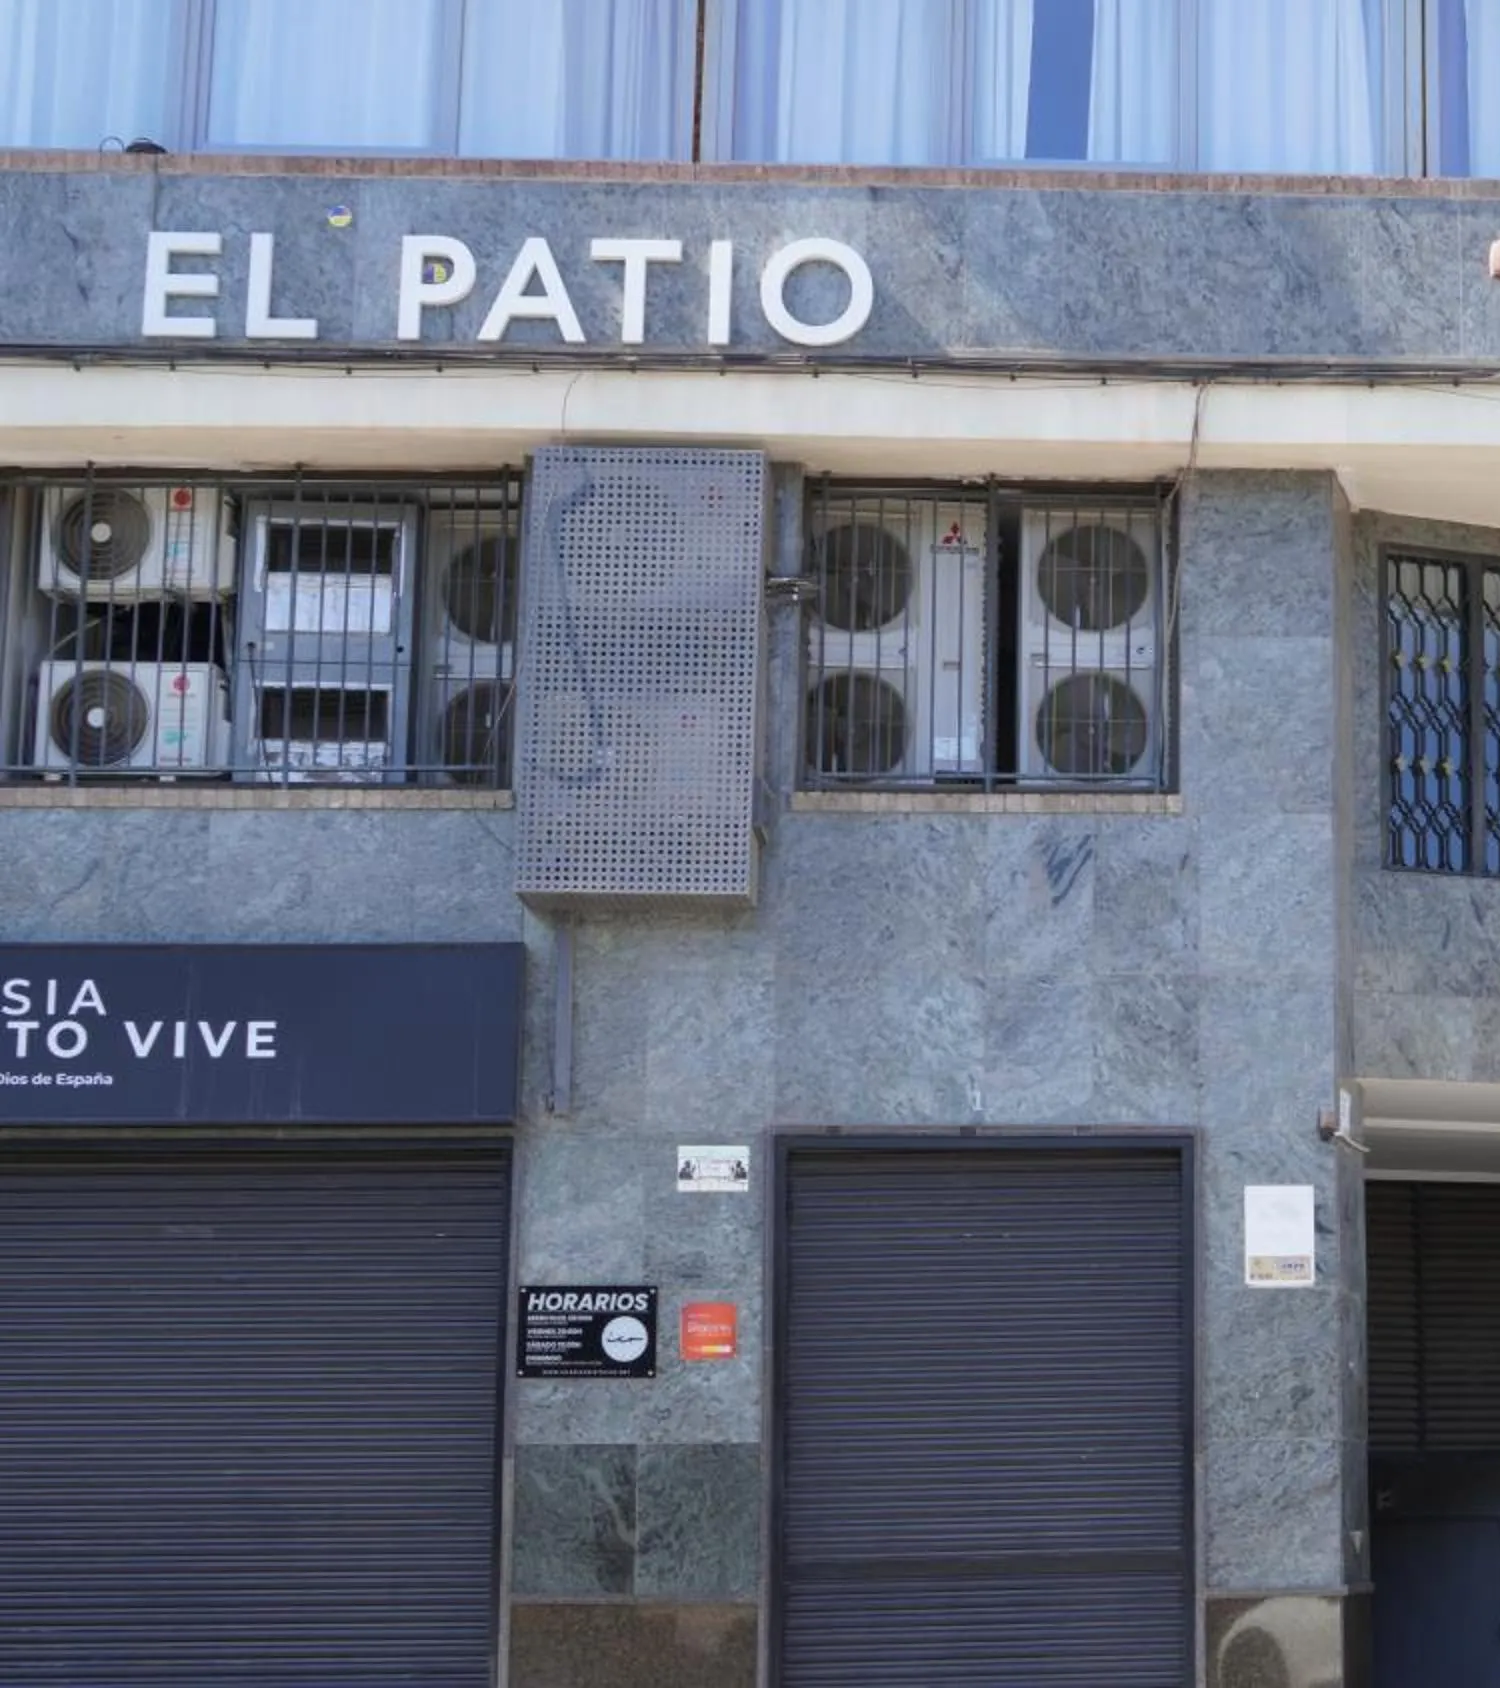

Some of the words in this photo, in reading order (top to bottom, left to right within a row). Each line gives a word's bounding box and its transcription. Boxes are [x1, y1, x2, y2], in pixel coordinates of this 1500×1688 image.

[143, 232, 318, 338] EL
[398, 235, 874, 346] PATIO
[1, 978, 107, 1016] SIA
[6, 1020, 88, 1059] TO
[123, 1020, 278, 1059] VIVE
[31, 1072, 53, 1086] de
[55, 1072, 114, 1089] España
[527, 1292, 649, 1312] HORARIOS
